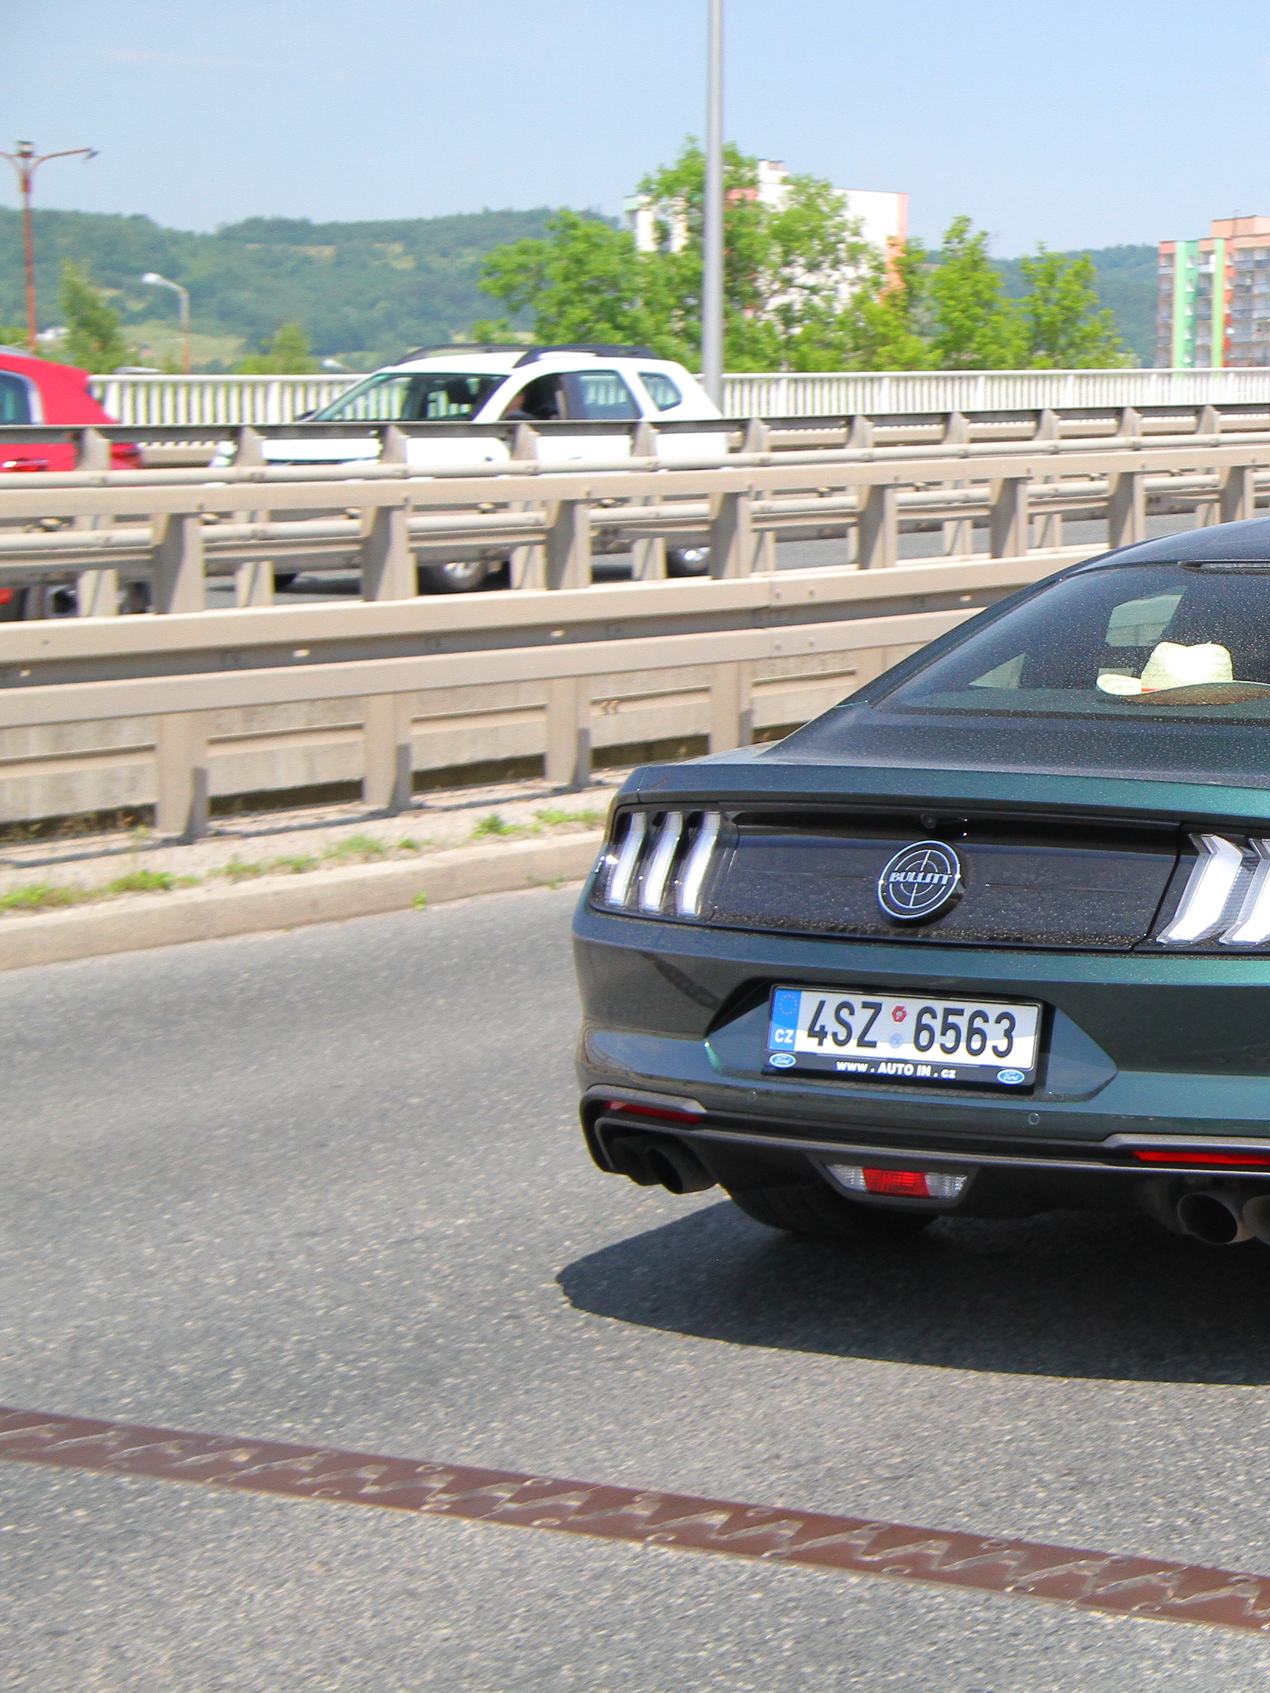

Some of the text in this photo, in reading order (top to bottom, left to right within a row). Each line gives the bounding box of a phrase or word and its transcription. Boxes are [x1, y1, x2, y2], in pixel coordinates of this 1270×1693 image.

[889, 871, 952, 885] BULLITT
[775, 1029, 794, 1043] CZ
[807, 1000, 1016, 1058] 4SZ 6563
[877, 1062, 914, 1076] AUTO
